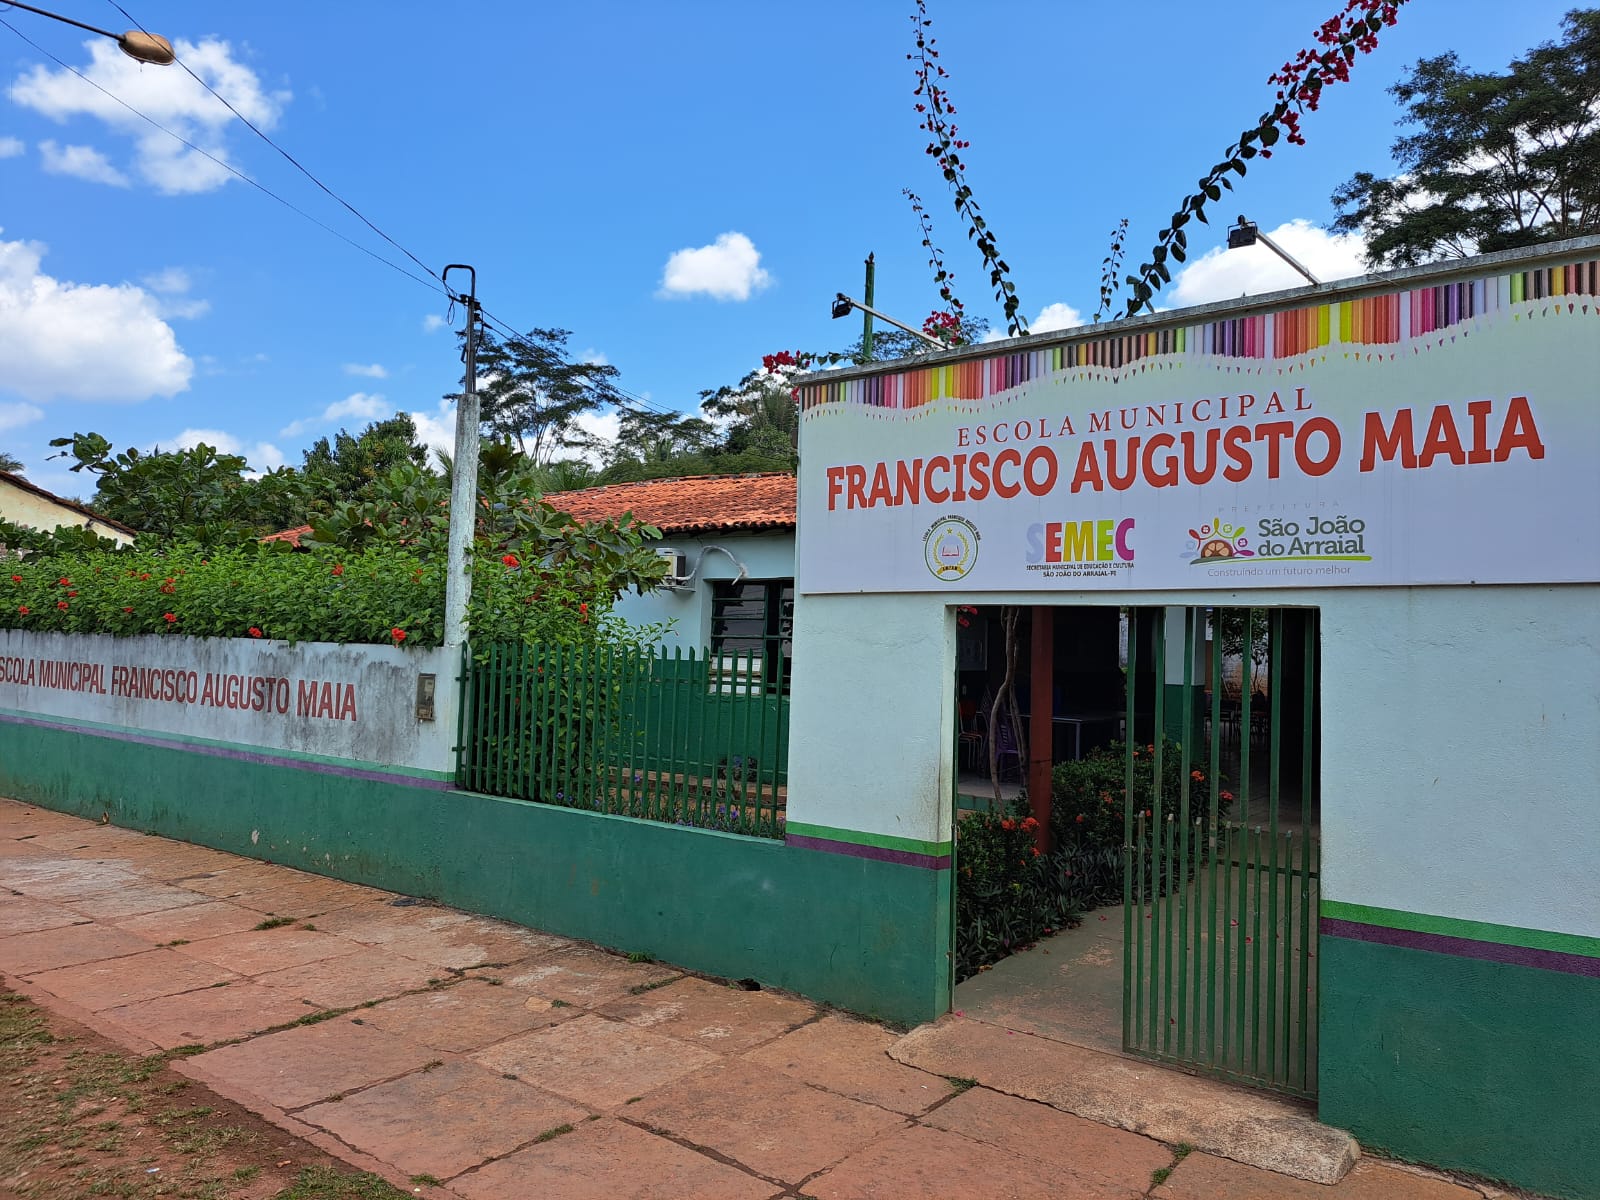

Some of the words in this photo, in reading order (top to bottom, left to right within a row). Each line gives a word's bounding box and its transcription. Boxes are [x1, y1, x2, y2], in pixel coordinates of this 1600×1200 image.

[957, 415, 1076, 447] ESCOLA
[1088, 388, 1313, 433] MUNICIPAL
[827, 446, 1058, 511] FRANCISCO
[1071, 417, 1341, 493] AUGUSTO
[1360, 397, 1544, 472] MAIA
[1218, 502, 1340, 512] PREFEITURA
[1026, 518, 1135, 563] SEMEC
[1258, 518, 1299, 537] São
[1306, 515, 1365, 535] João
[1258, 540, 1284, 556] do
[1288, 535, 1364, 556] Arraial
[1207, 566, 1263, 577] Construindo
[1266, 568, 1281, 576] um
[1283, 567, 1312, 576] futuro
[1316, 564, 1351, 575] melhor
[39, 659, 107, 695] MUNICIPAL
[111, 665, 198, 704] FRANCISCO
[200, 672, 289, 714] AUGUSTO
[297, 679, 357, 721] MAIA
